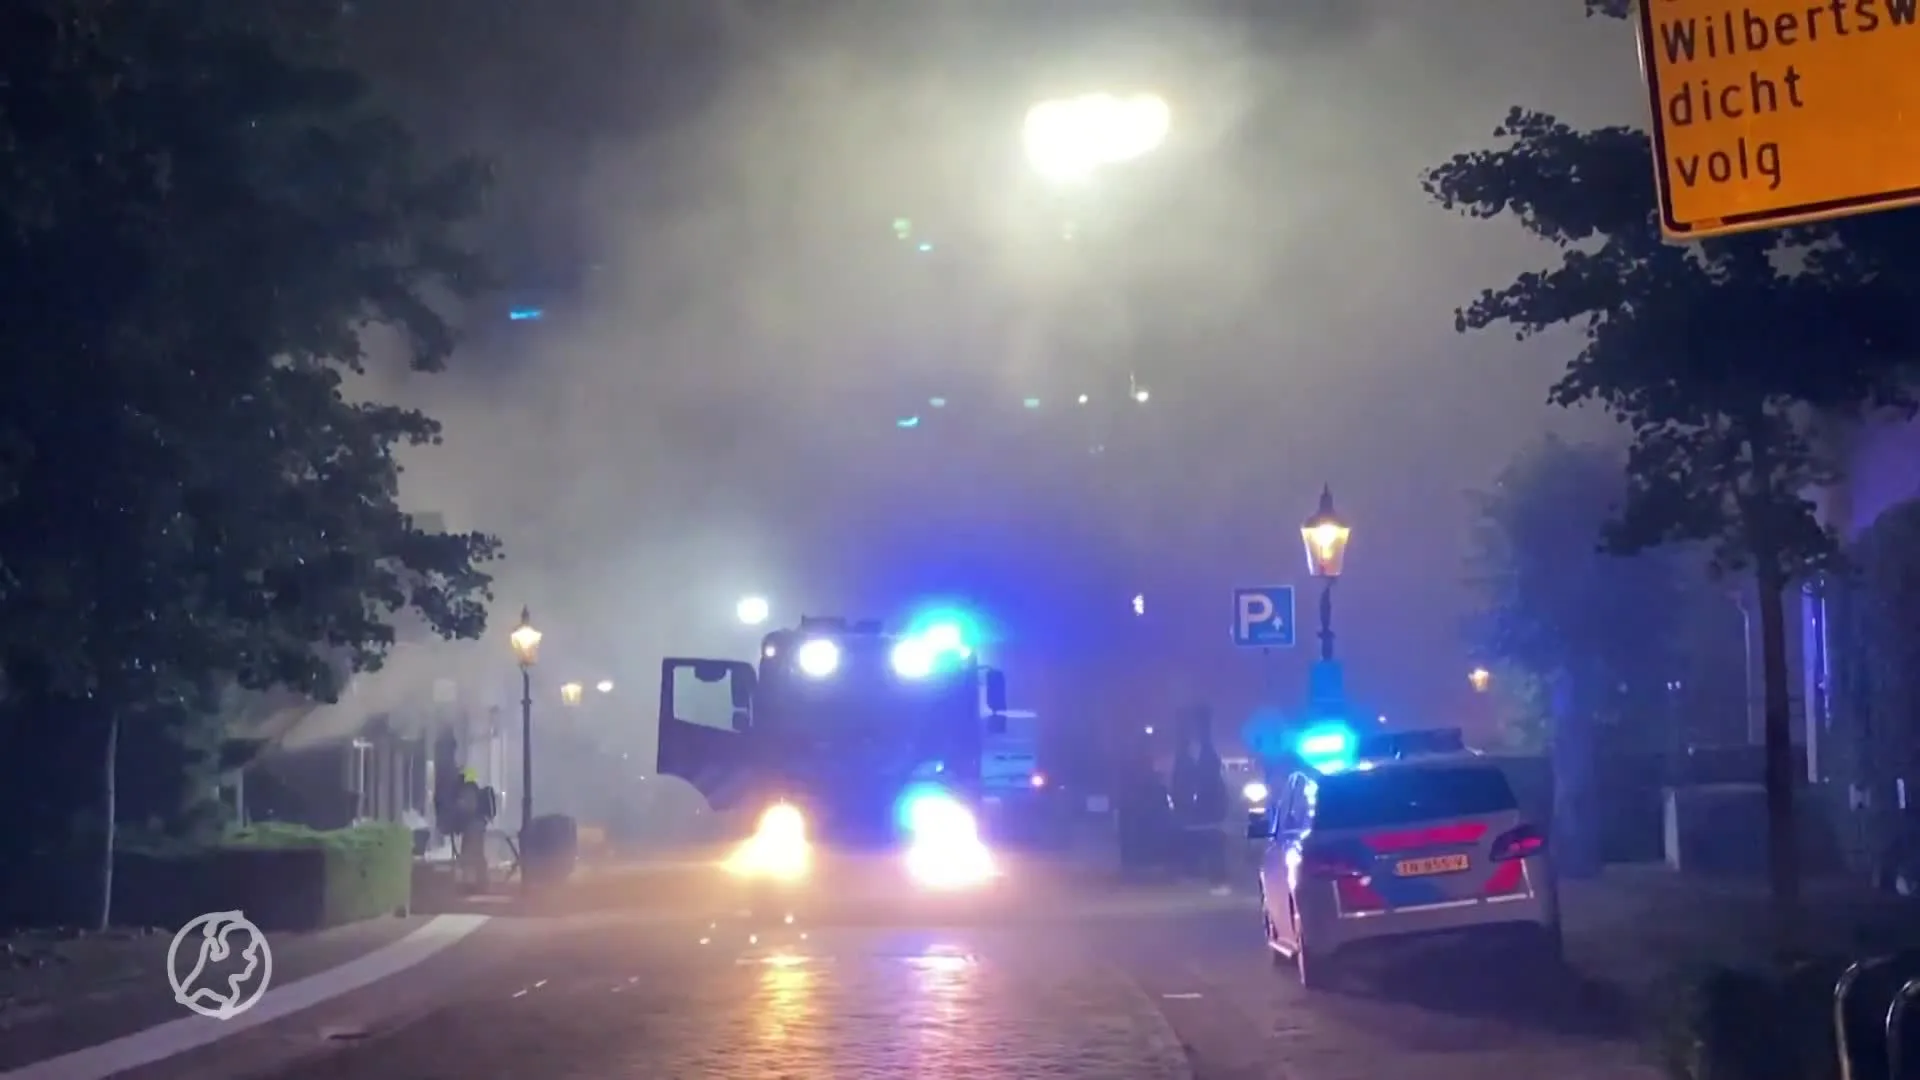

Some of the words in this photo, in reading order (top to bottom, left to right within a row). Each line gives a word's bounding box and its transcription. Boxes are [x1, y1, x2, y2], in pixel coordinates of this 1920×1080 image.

[1669, 65, 1803, 126] dicht
[1675, 137, 1781, 190] volg
[1239, 594, 1273, 639] P
